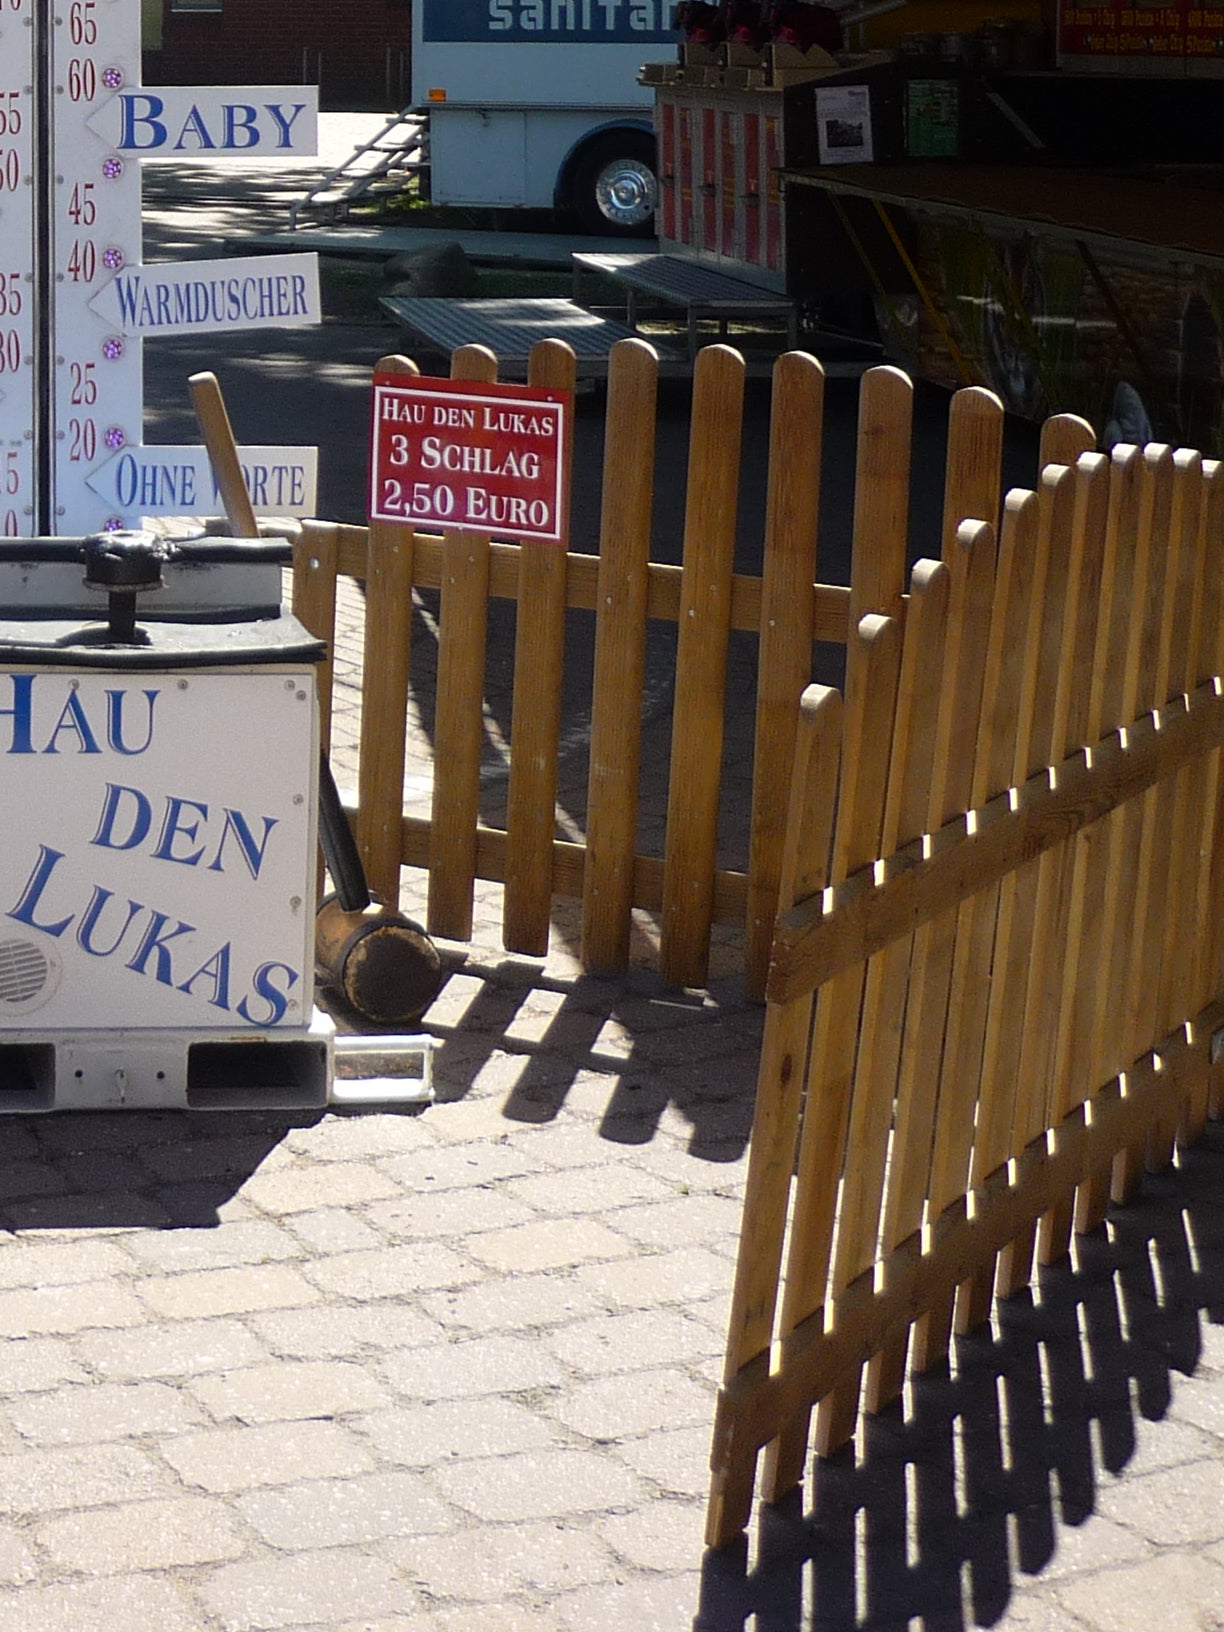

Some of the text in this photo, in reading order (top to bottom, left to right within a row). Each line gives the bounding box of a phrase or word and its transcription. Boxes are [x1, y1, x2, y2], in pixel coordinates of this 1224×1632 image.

[70, 2, 96, 45] 65
[69, 60, 95, 101] 60
[120, 95, 304, 149] BABY
[69, 183, 95, 225] 45
[68, 243, 95, 282] 40
[115, 274, 308, 326] WARMDUSCHER
[70, 363, 97, 405] 25
[382, 397, 553, 436] HAU DEN LUKAS
[70, 419, 96, 461] 20
[390, 435, 539, 479] 3 SCHLAG
[116, 455, 305, 507] OHNE RTE
[384, 479, 548, 526] 2,50 EURO
[89, 782, 279, 880] DEN
[5, 844, 299, 1027] LUKAS
